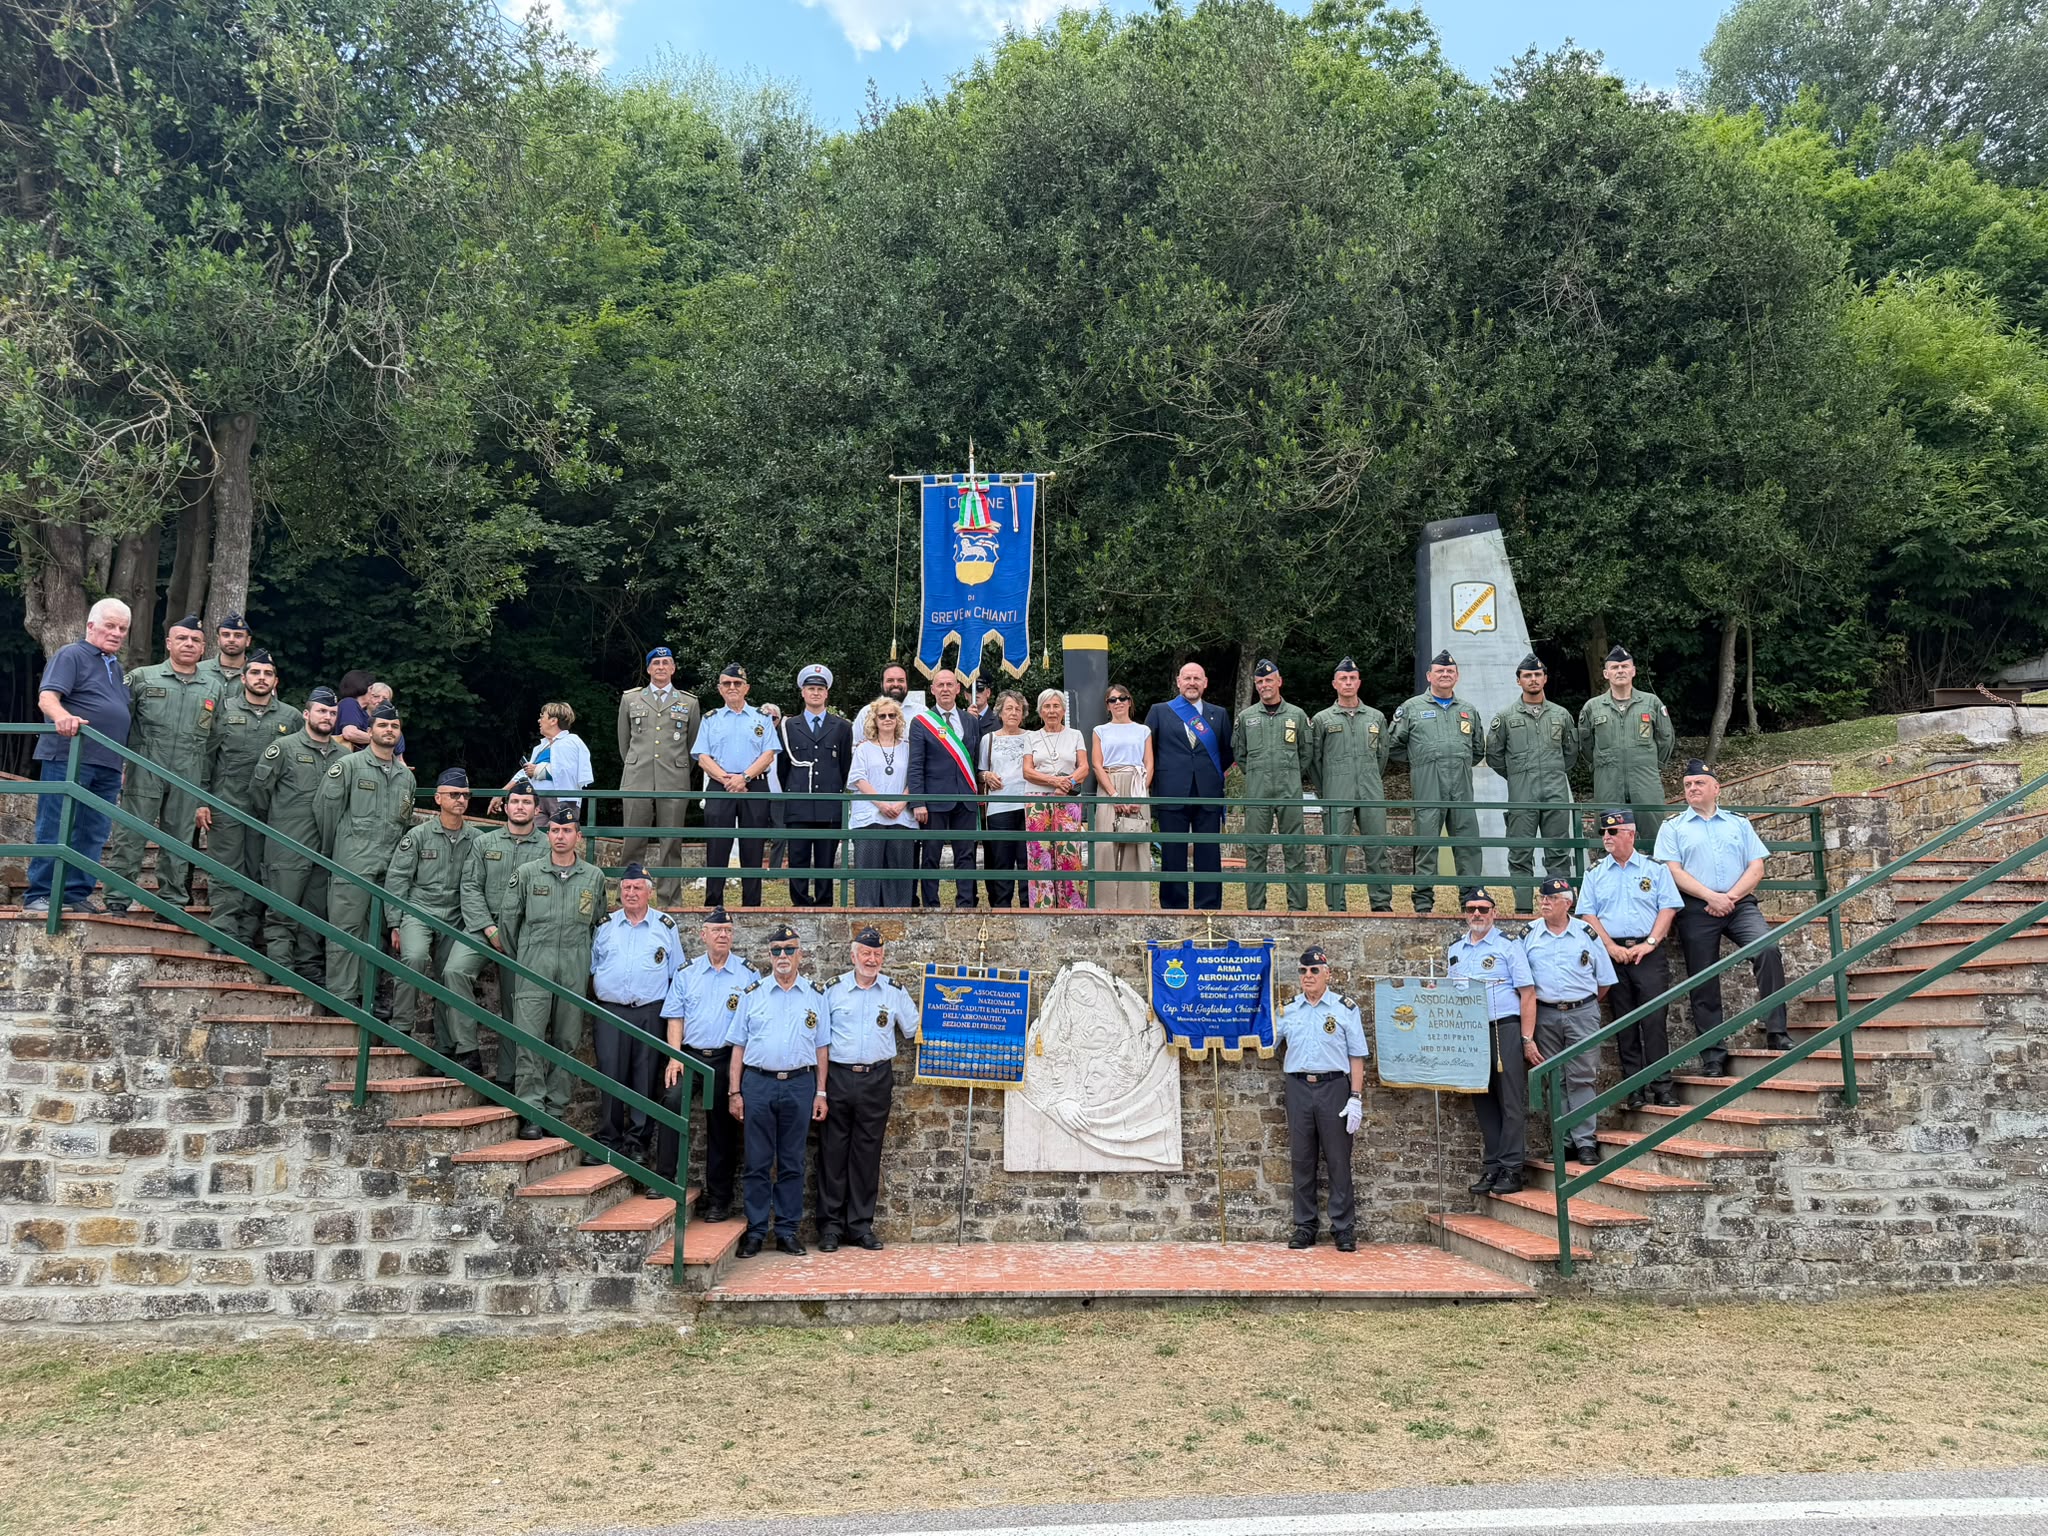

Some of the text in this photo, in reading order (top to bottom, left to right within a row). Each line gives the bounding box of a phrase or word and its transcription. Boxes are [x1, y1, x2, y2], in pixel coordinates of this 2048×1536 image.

[932, 610, 964, 623] GREVE
[974, 607, 1017, 622] CHIANTI
[1196, 956, 1262, 964] ASSOCIAZIONE
[973, 990, 1020, 998] ASSOCIAZIONE
[1414, 994, 1482, 1005] ASSOCIAZIONE
[960, 1005, 985, 1013] CADUTI
[991, 1007, 1023, 1015] MUTILATI
[1195, 1004, 1232, 1016] Guglielmo
[1428, 1008, 1463, 1019] ARMA
[980, 1023, 1006, 1031] FIRENZE
[1428, 1021, 1482, 1029] AERONAUTICA
